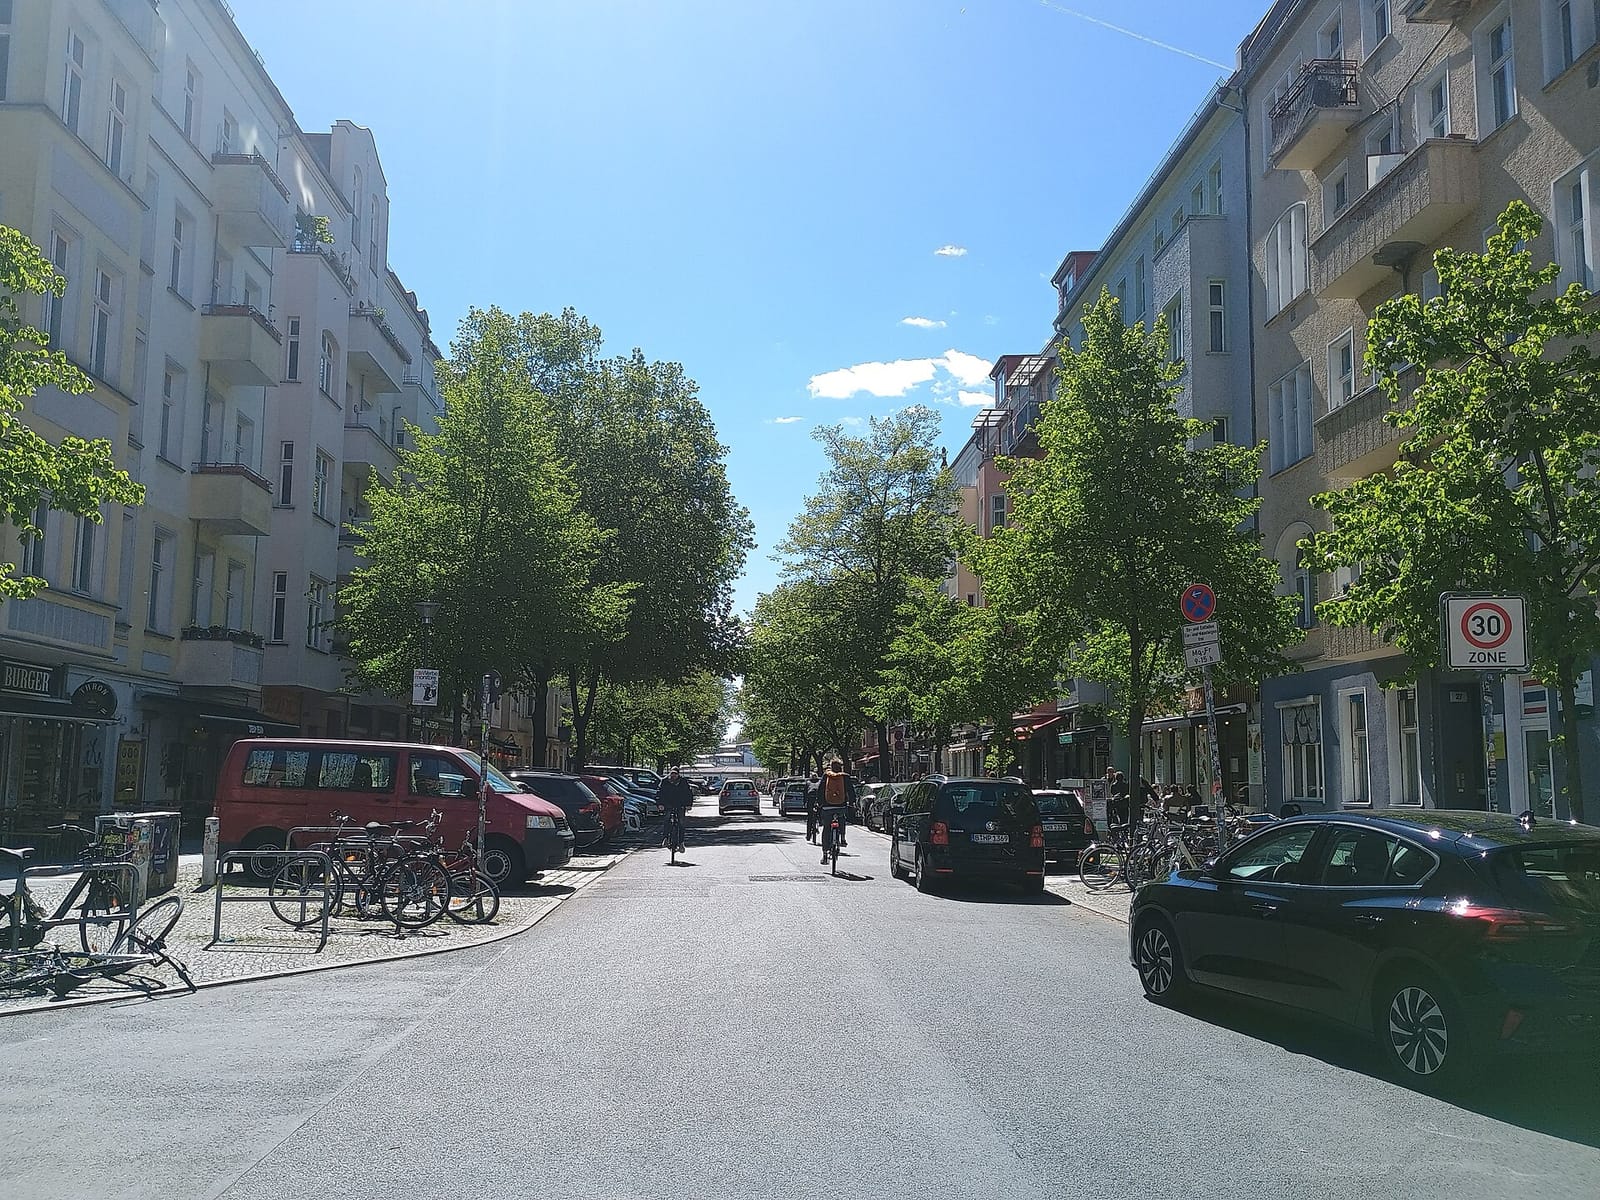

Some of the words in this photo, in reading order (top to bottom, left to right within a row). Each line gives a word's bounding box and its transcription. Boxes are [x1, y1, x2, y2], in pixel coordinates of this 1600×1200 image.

[1471, 615, 1501, 636] 30
[1468, 651, 1507, 663] ZONE
[4, 665, 50, 692] BURGER
